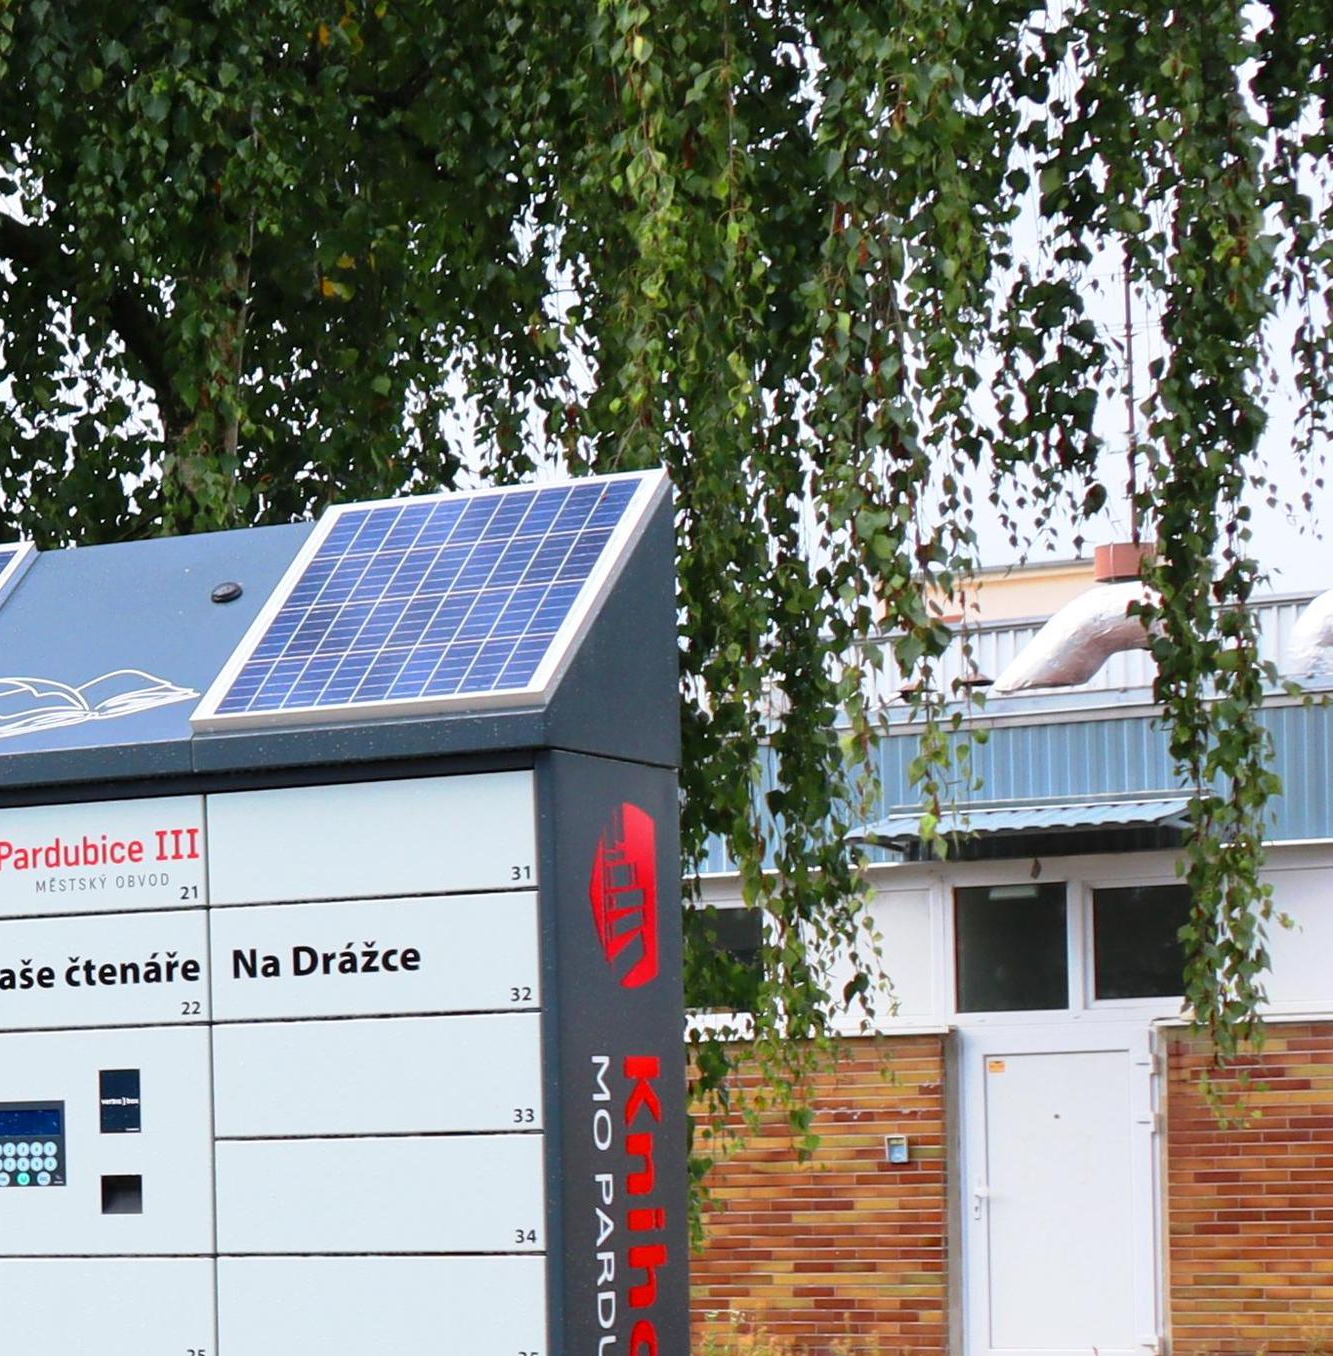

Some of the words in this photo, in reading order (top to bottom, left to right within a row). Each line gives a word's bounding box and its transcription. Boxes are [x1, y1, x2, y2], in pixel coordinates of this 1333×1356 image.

[155, 828, 199, 861] III
[511, 866, 531, 880] 31
[36, 874, 107, 893] MĚSTSKÝ
[116, 872, 169, 889] OBVOD
[180, 886, 199, 900] 21
[66, 951, 200, 987] čtenáře
[233, 947, 279, 979] Na
[293, 941, 422, 977] Drážce
[511, 987, 532, 1001] 32
[181, 1001, 201, 1015] 22
[591, 1055, 613, 1151] MO
[513, 1109, 534, 1123] 33
[515, 1230, 537, 1244] 34
